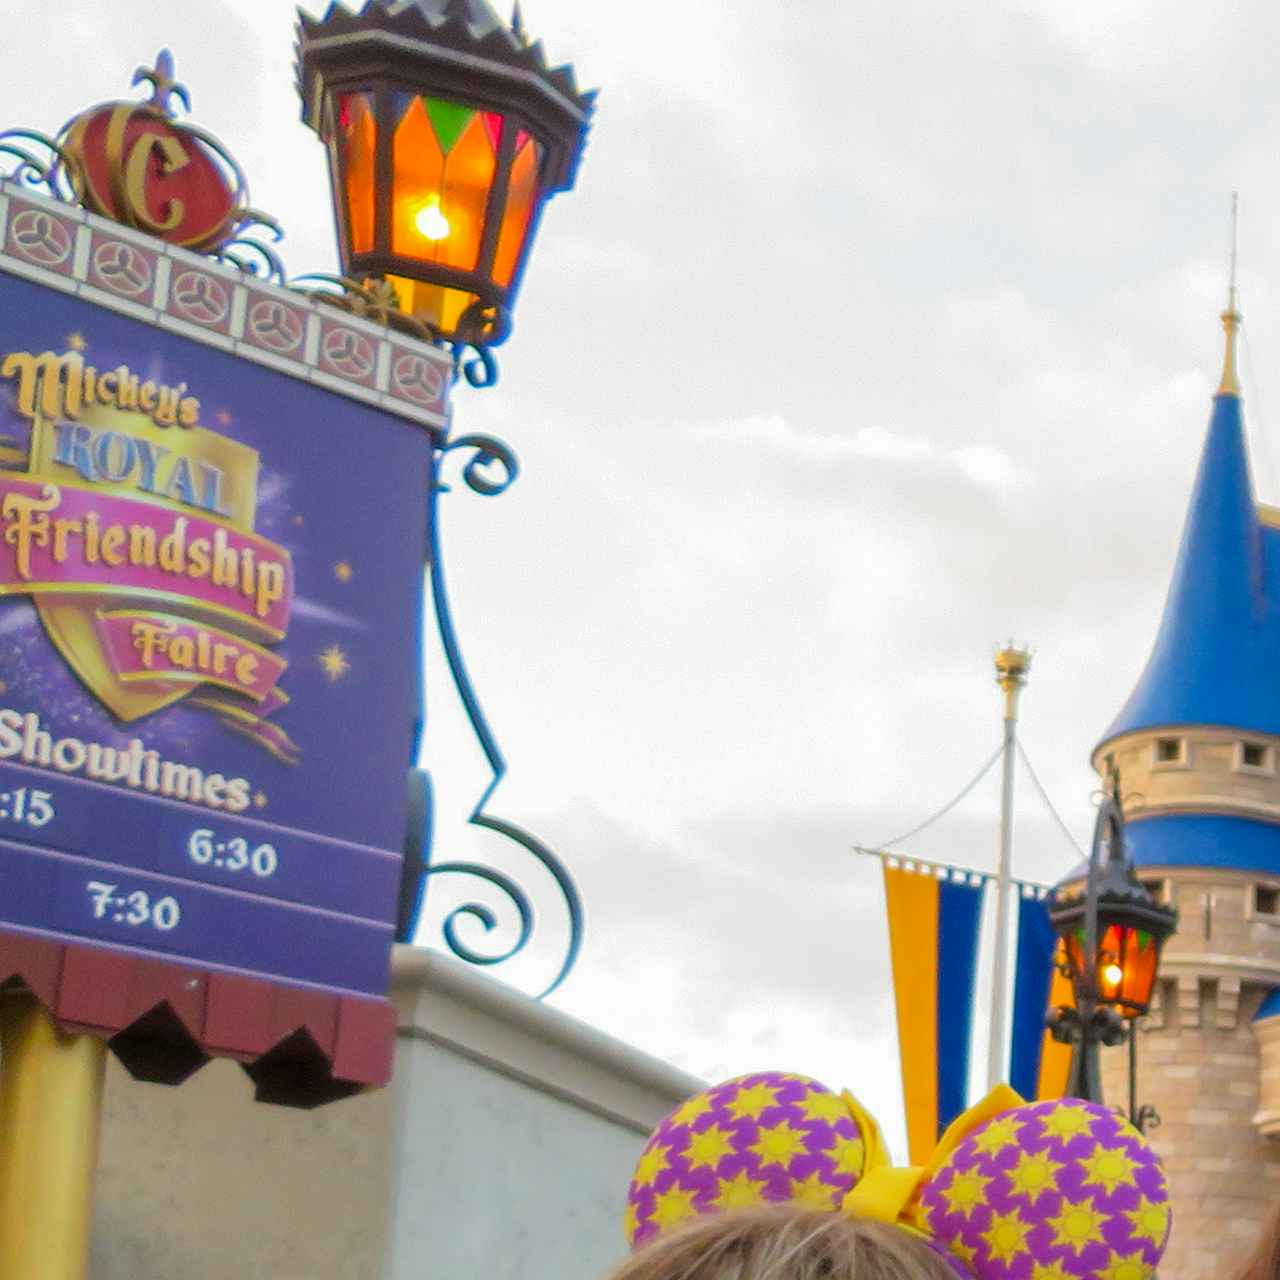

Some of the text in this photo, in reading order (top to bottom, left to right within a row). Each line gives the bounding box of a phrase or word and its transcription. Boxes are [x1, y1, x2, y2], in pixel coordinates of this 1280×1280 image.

[1, 350, 201, 429] Mickey's
[54, 420, 236, 520] ROYAL
[2, 484, 285, 617] Friendship
[132, 621, 259, 685] Faire
[0, 708, 251, 812] Showtimes
[188, 828, 278, 877] 6:30
[87, 881, 180, 929] 7:30
